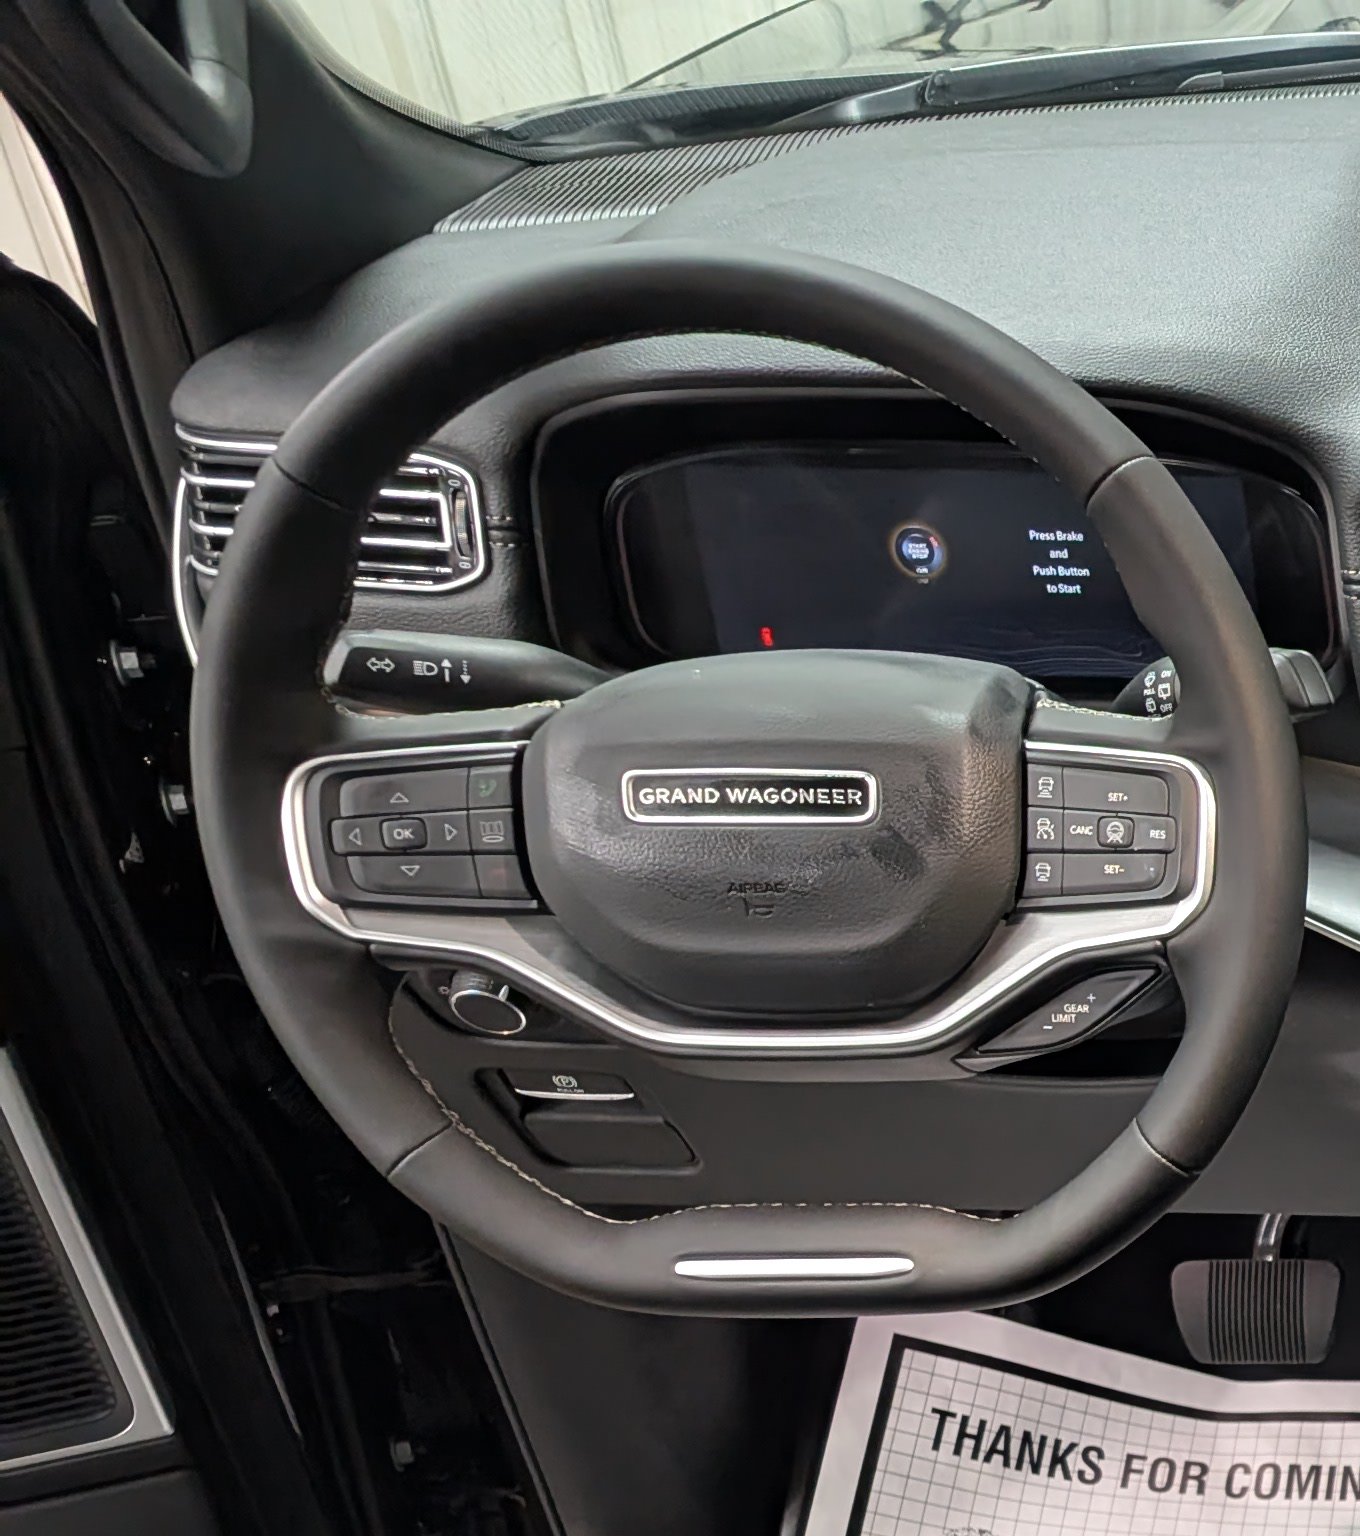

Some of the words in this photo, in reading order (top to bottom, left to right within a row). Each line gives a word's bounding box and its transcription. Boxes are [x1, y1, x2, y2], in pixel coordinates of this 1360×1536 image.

[1029, 529, 1055, 542] Press
[1056, 529, 1084, 542] Brake
[1049, 548, 1069, 559] and
[1032, 564, 1057, 577] Push
[1058, 565, 1090, 577] Button
[1046, 583, 1057, 594] to
[1058, 583, 1081, 594] Start
[639, 787, 720, 805] GRAND
[726, 787, 862, 805] WAGONEER
[393, 828, 415, 841] OK
[1070, 824, 1093, 835] CANC
[1150, 829, 1166, 839] RES
[1063, 1003, 1089, 1013] GEAR
[1051, 1013, 1076, 1023] LIMIT
[931, 1407, 1105, 1485] THANKS
[1120, 1453, 1210, 1496] FOR
